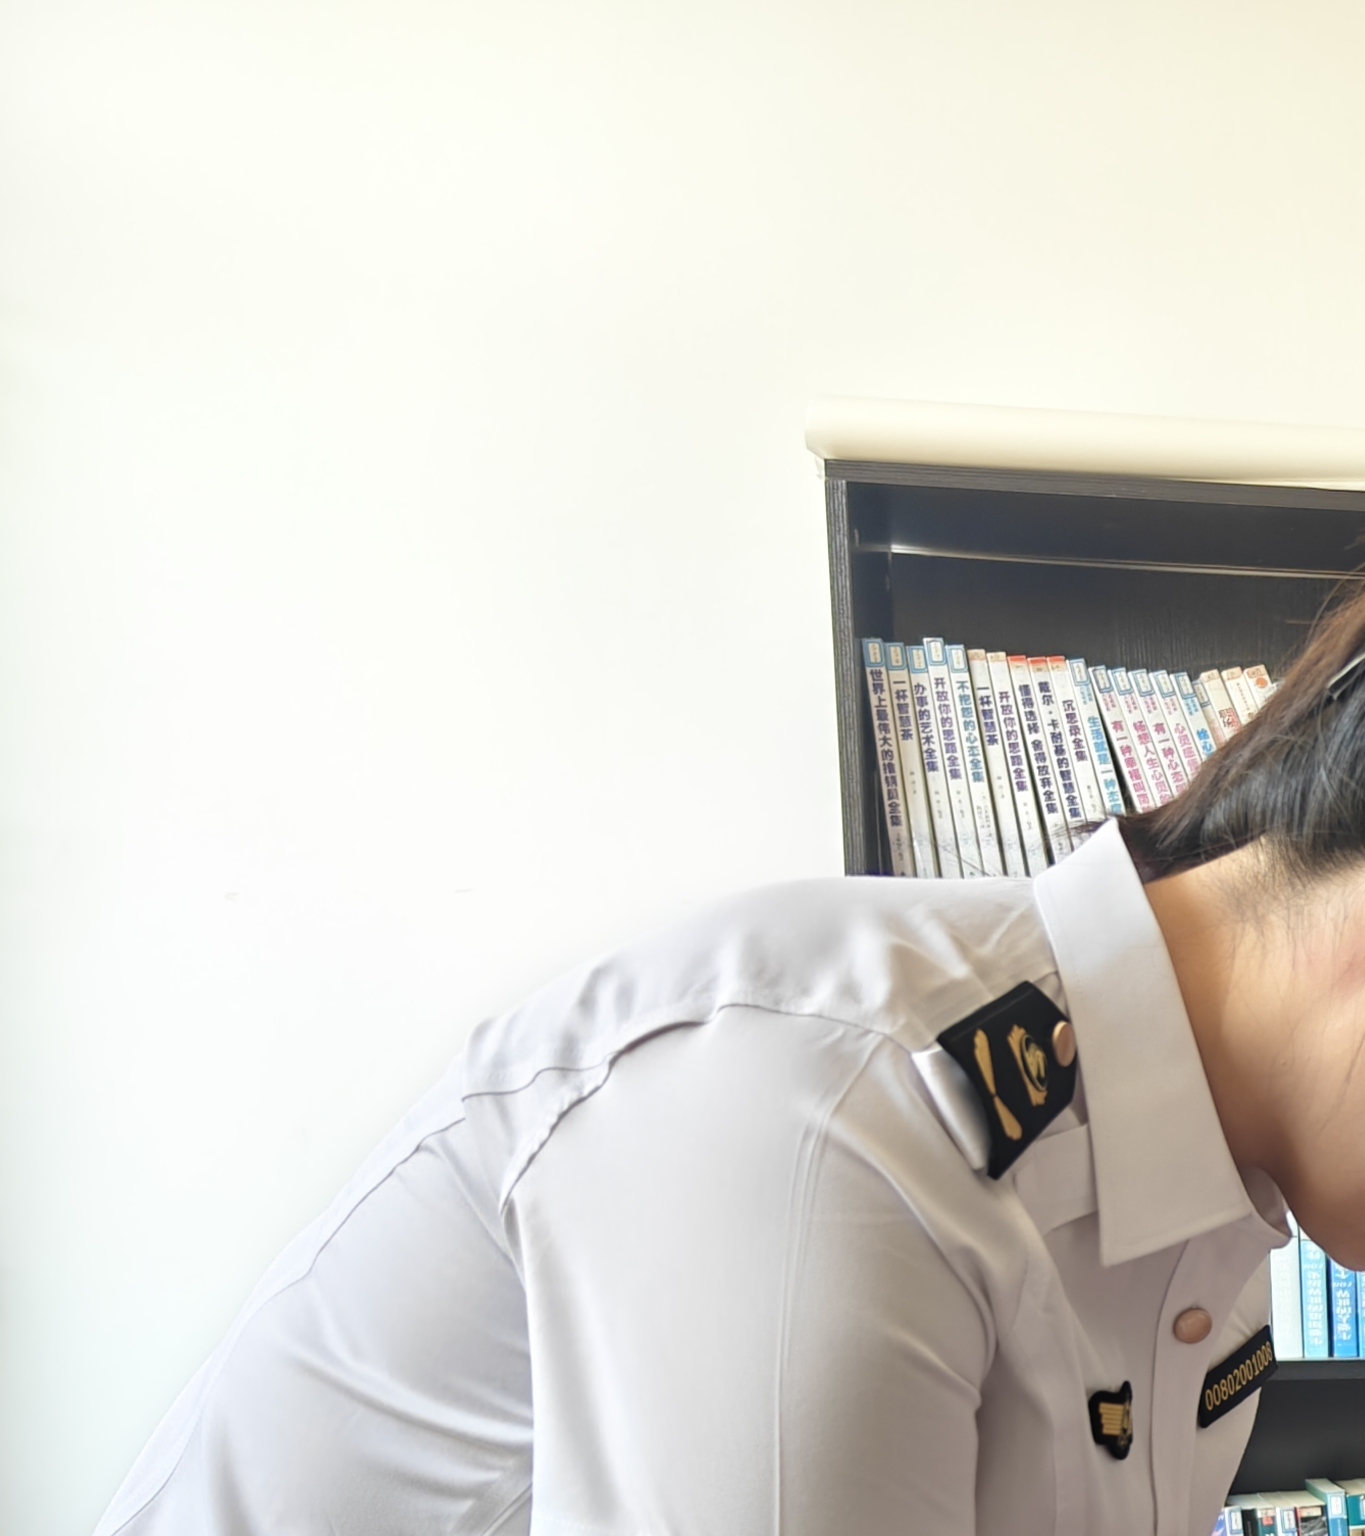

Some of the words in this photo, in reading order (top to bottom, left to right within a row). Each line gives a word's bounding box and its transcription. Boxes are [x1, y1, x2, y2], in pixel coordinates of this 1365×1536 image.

[870, 669, 903, 827] 世界上最伟大的推销员全集
[893, 681, 914, 741] 一杯智慧茶
[914, 683, 939, 772] 办事的艺术全集
[934, 678, 962, 780] 开放你的思路全集
[956, 681, 985, 783] 不抱怨的心态全集
[976, 686, 999, 746] 一杯智慧茶
[999, 691, 1028, 792] 开放你的思路全集
[1018, 684, 1041, 735] 懂得选择
[1031, 739, 1059, 815] 舍得放弃全集
[1062, 699, 1088, 762] 沉思录全集
